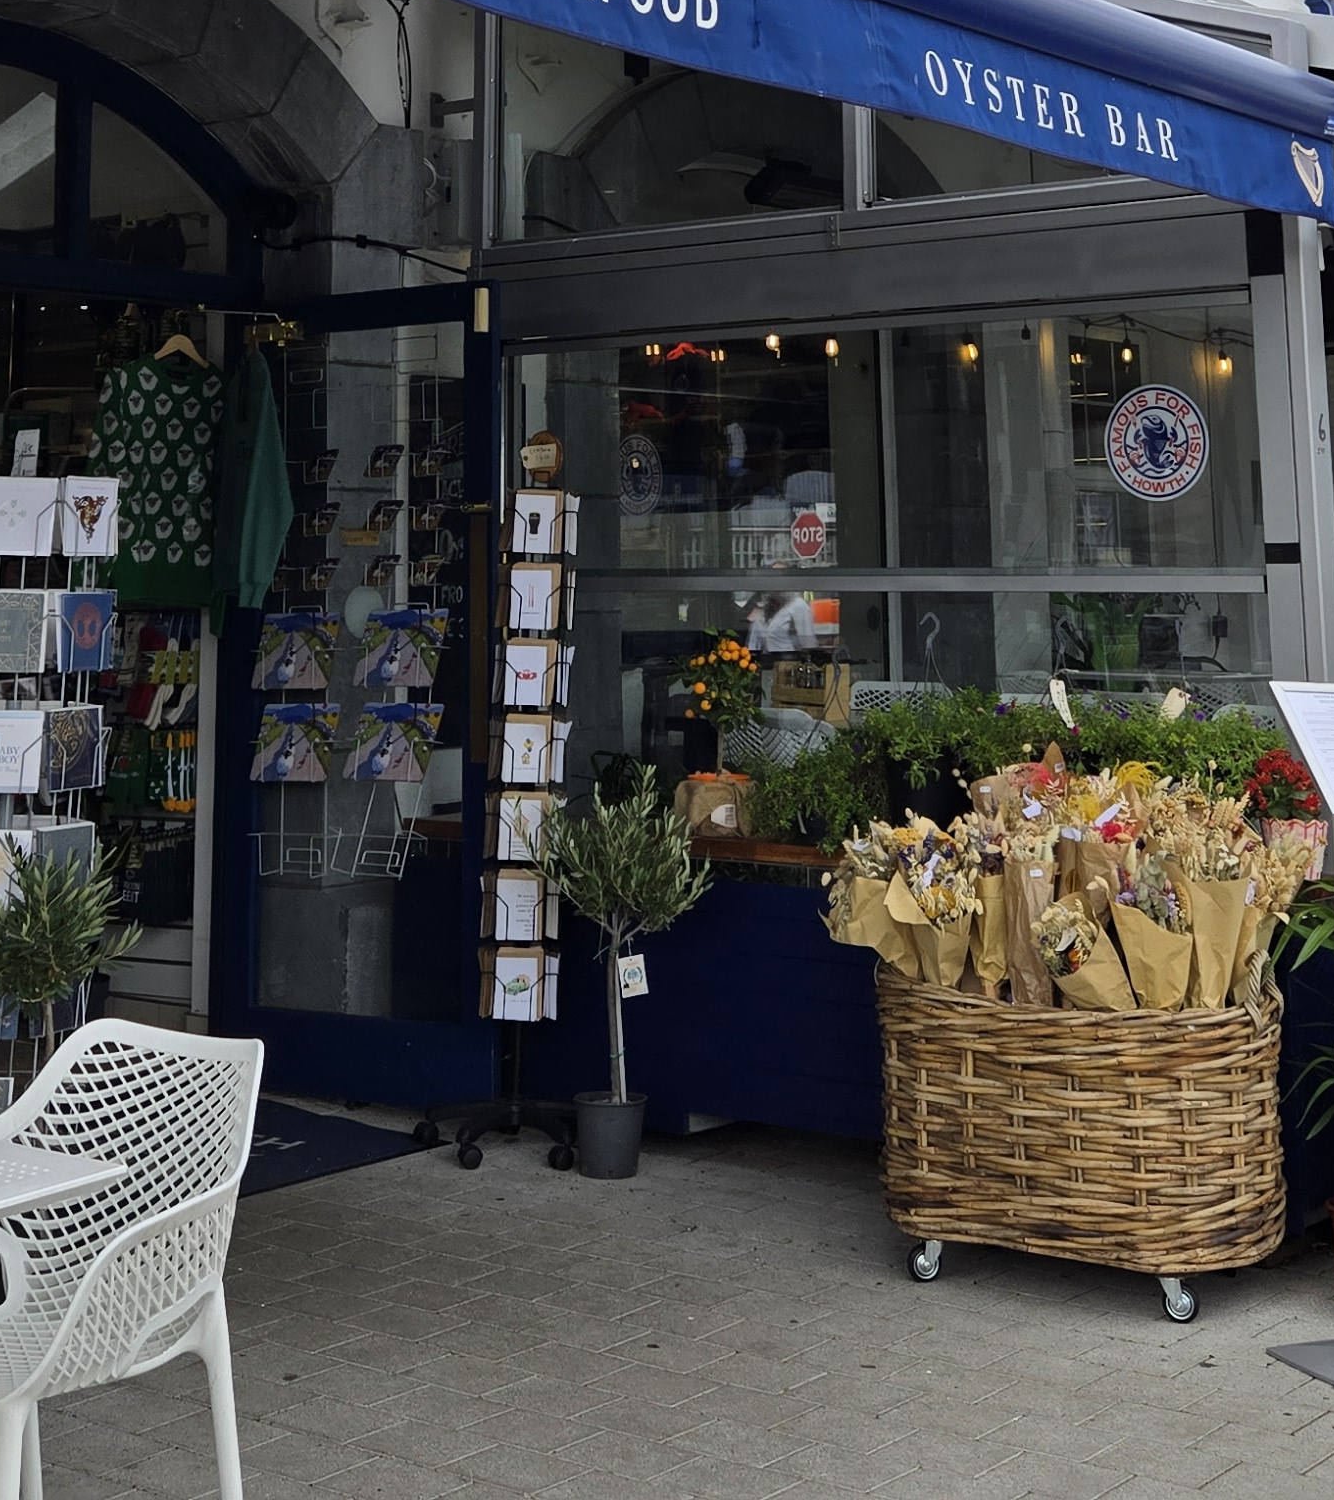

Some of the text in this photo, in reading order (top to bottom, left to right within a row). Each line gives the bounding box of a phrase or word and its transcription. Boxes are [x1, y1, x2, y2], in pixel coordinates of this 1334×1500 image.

[925, 50, 1179, 163] OYSTER BAR
[1112, 391, 1202, 474] FAMOUS FOR FISH
[1131, 472, 1187, 493] HOWTH
